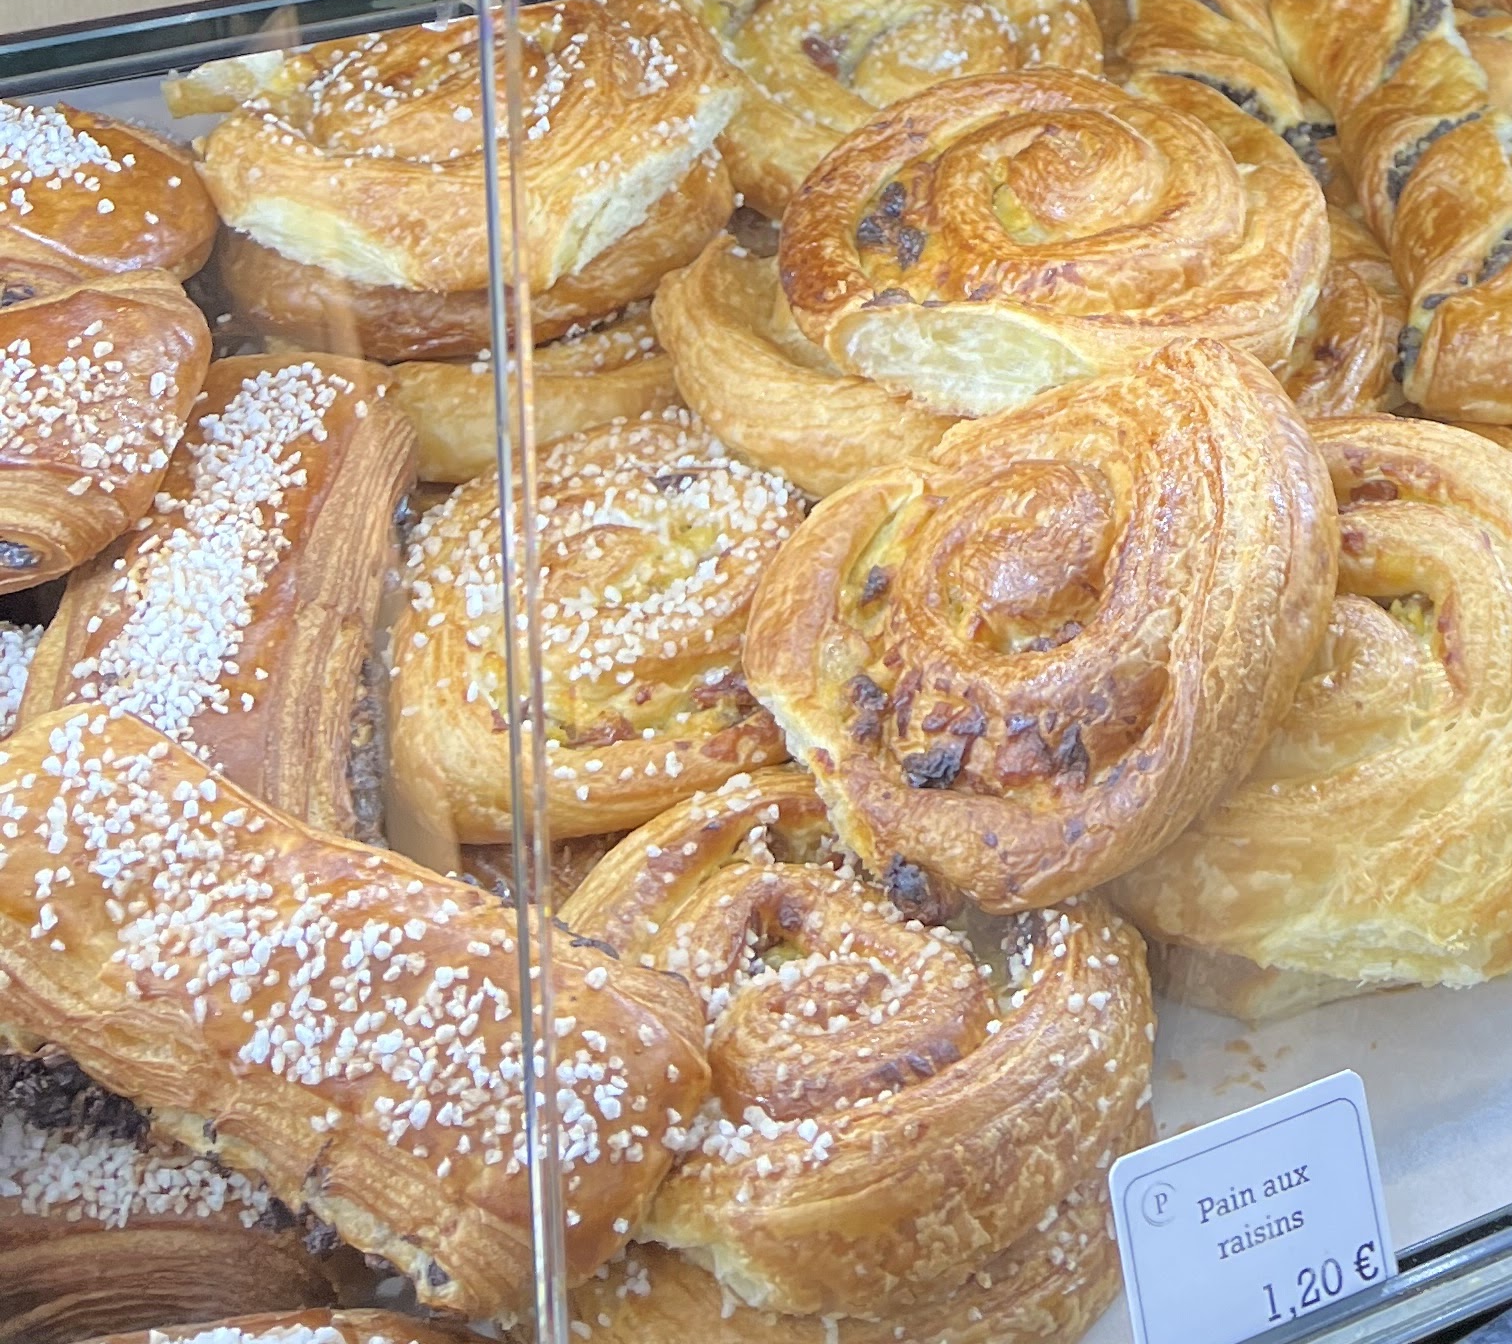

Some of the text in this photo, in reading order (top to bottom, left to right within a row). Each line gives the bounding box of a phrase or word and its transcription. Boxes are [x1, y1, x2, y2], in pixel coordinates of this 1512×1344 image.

[1155, 1193, 1168, 1213] P
[1197, 1165, 1310, 1223] Pain aux
[1217, 1209, 1304, 1259] raisins
[1263, 1241, 1378, 1322] 1,20 €
